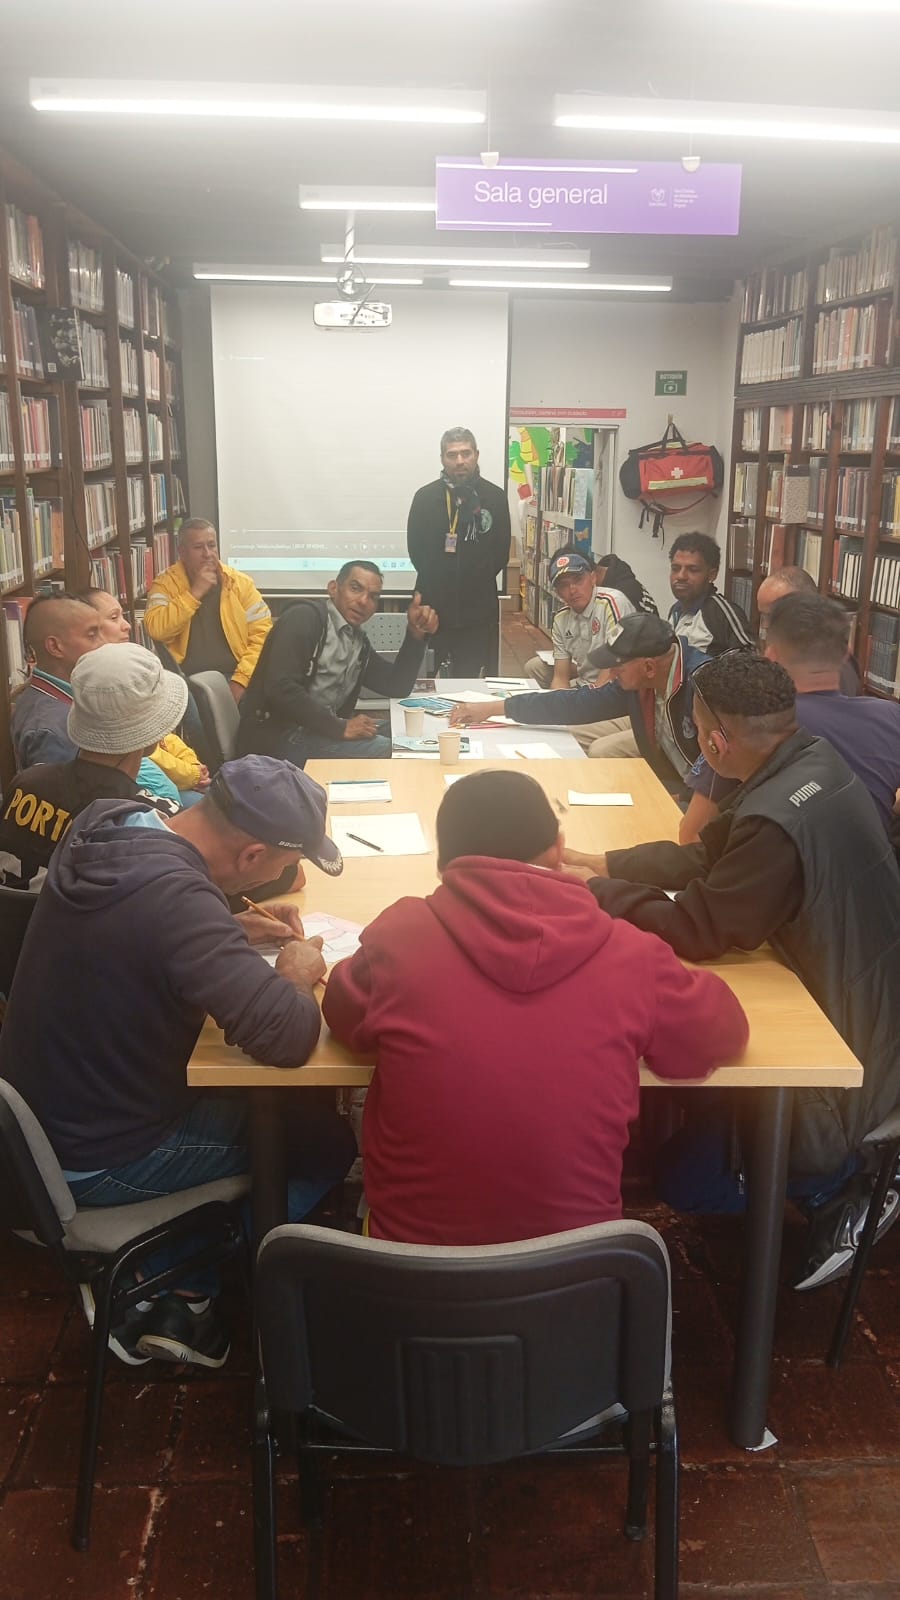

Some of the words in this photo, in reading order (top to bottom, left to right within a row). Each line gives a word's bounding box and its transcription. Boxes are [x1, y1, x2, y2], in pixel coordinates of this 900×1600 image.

[474, 180, 523, 204] Sala
[528, 183, 608, 209] general
[789, 780, 822, 807] PUMA
[4, 788, 73, 842] PORT
